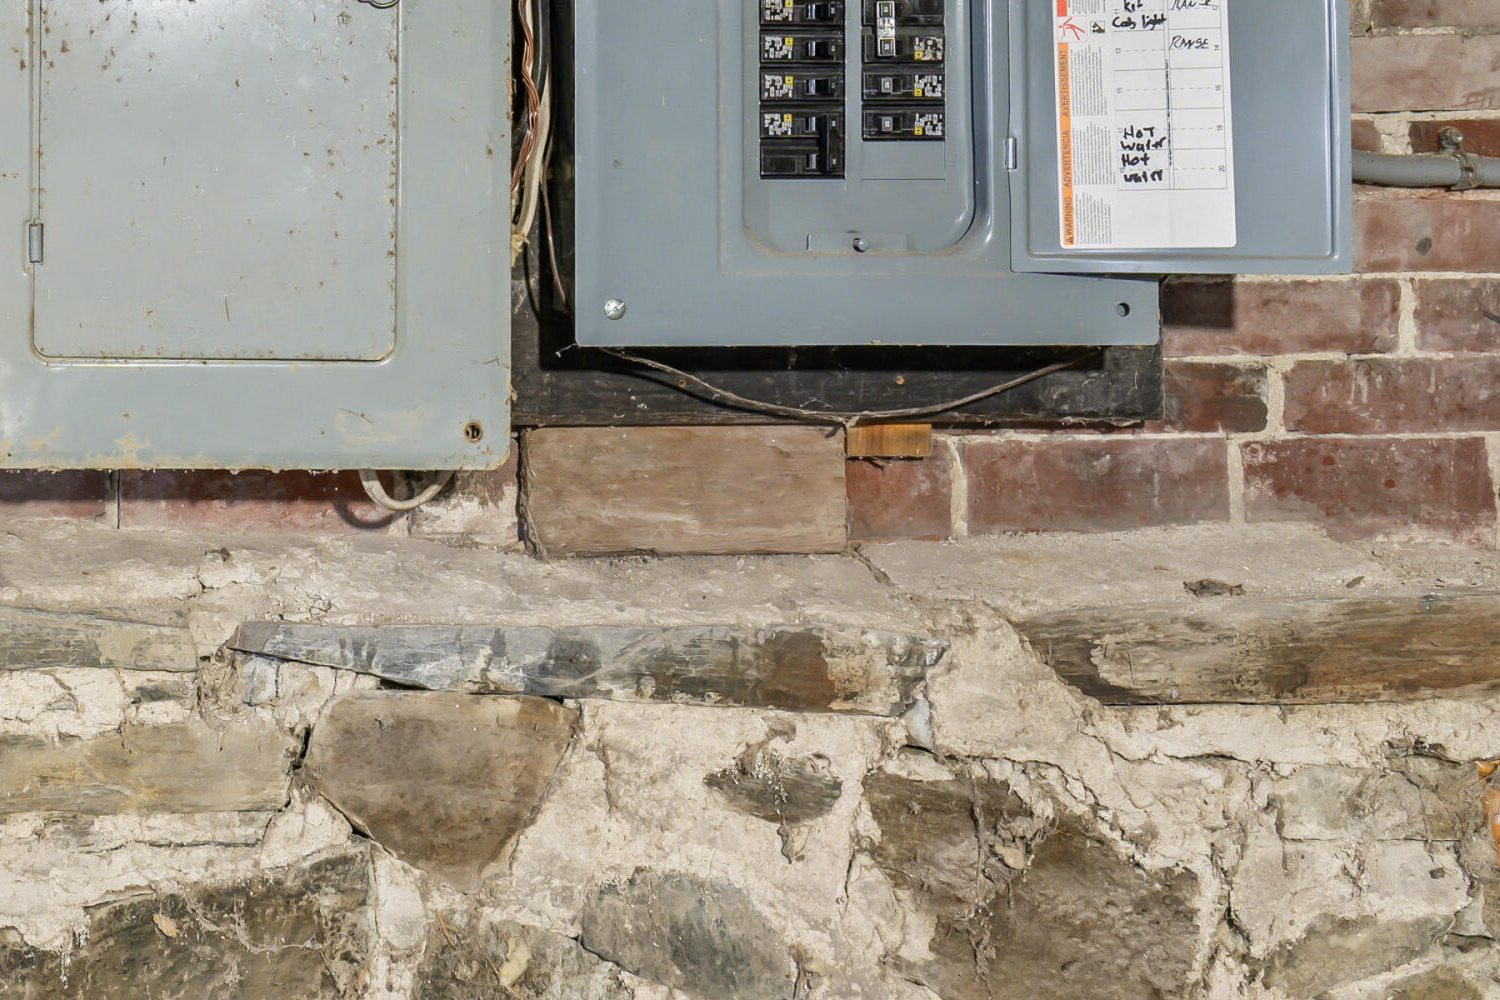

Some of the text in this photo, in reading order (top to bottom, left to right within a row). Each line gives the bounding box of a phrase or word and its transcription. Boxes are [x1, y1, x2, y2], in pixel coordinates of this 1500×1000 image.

[1059, 50, 1069, 118] AVERTISSEMENT
[1062, 129, 1072, 188] ADVERTENCIA
[1064, 196, 1073, 237] WARNING
